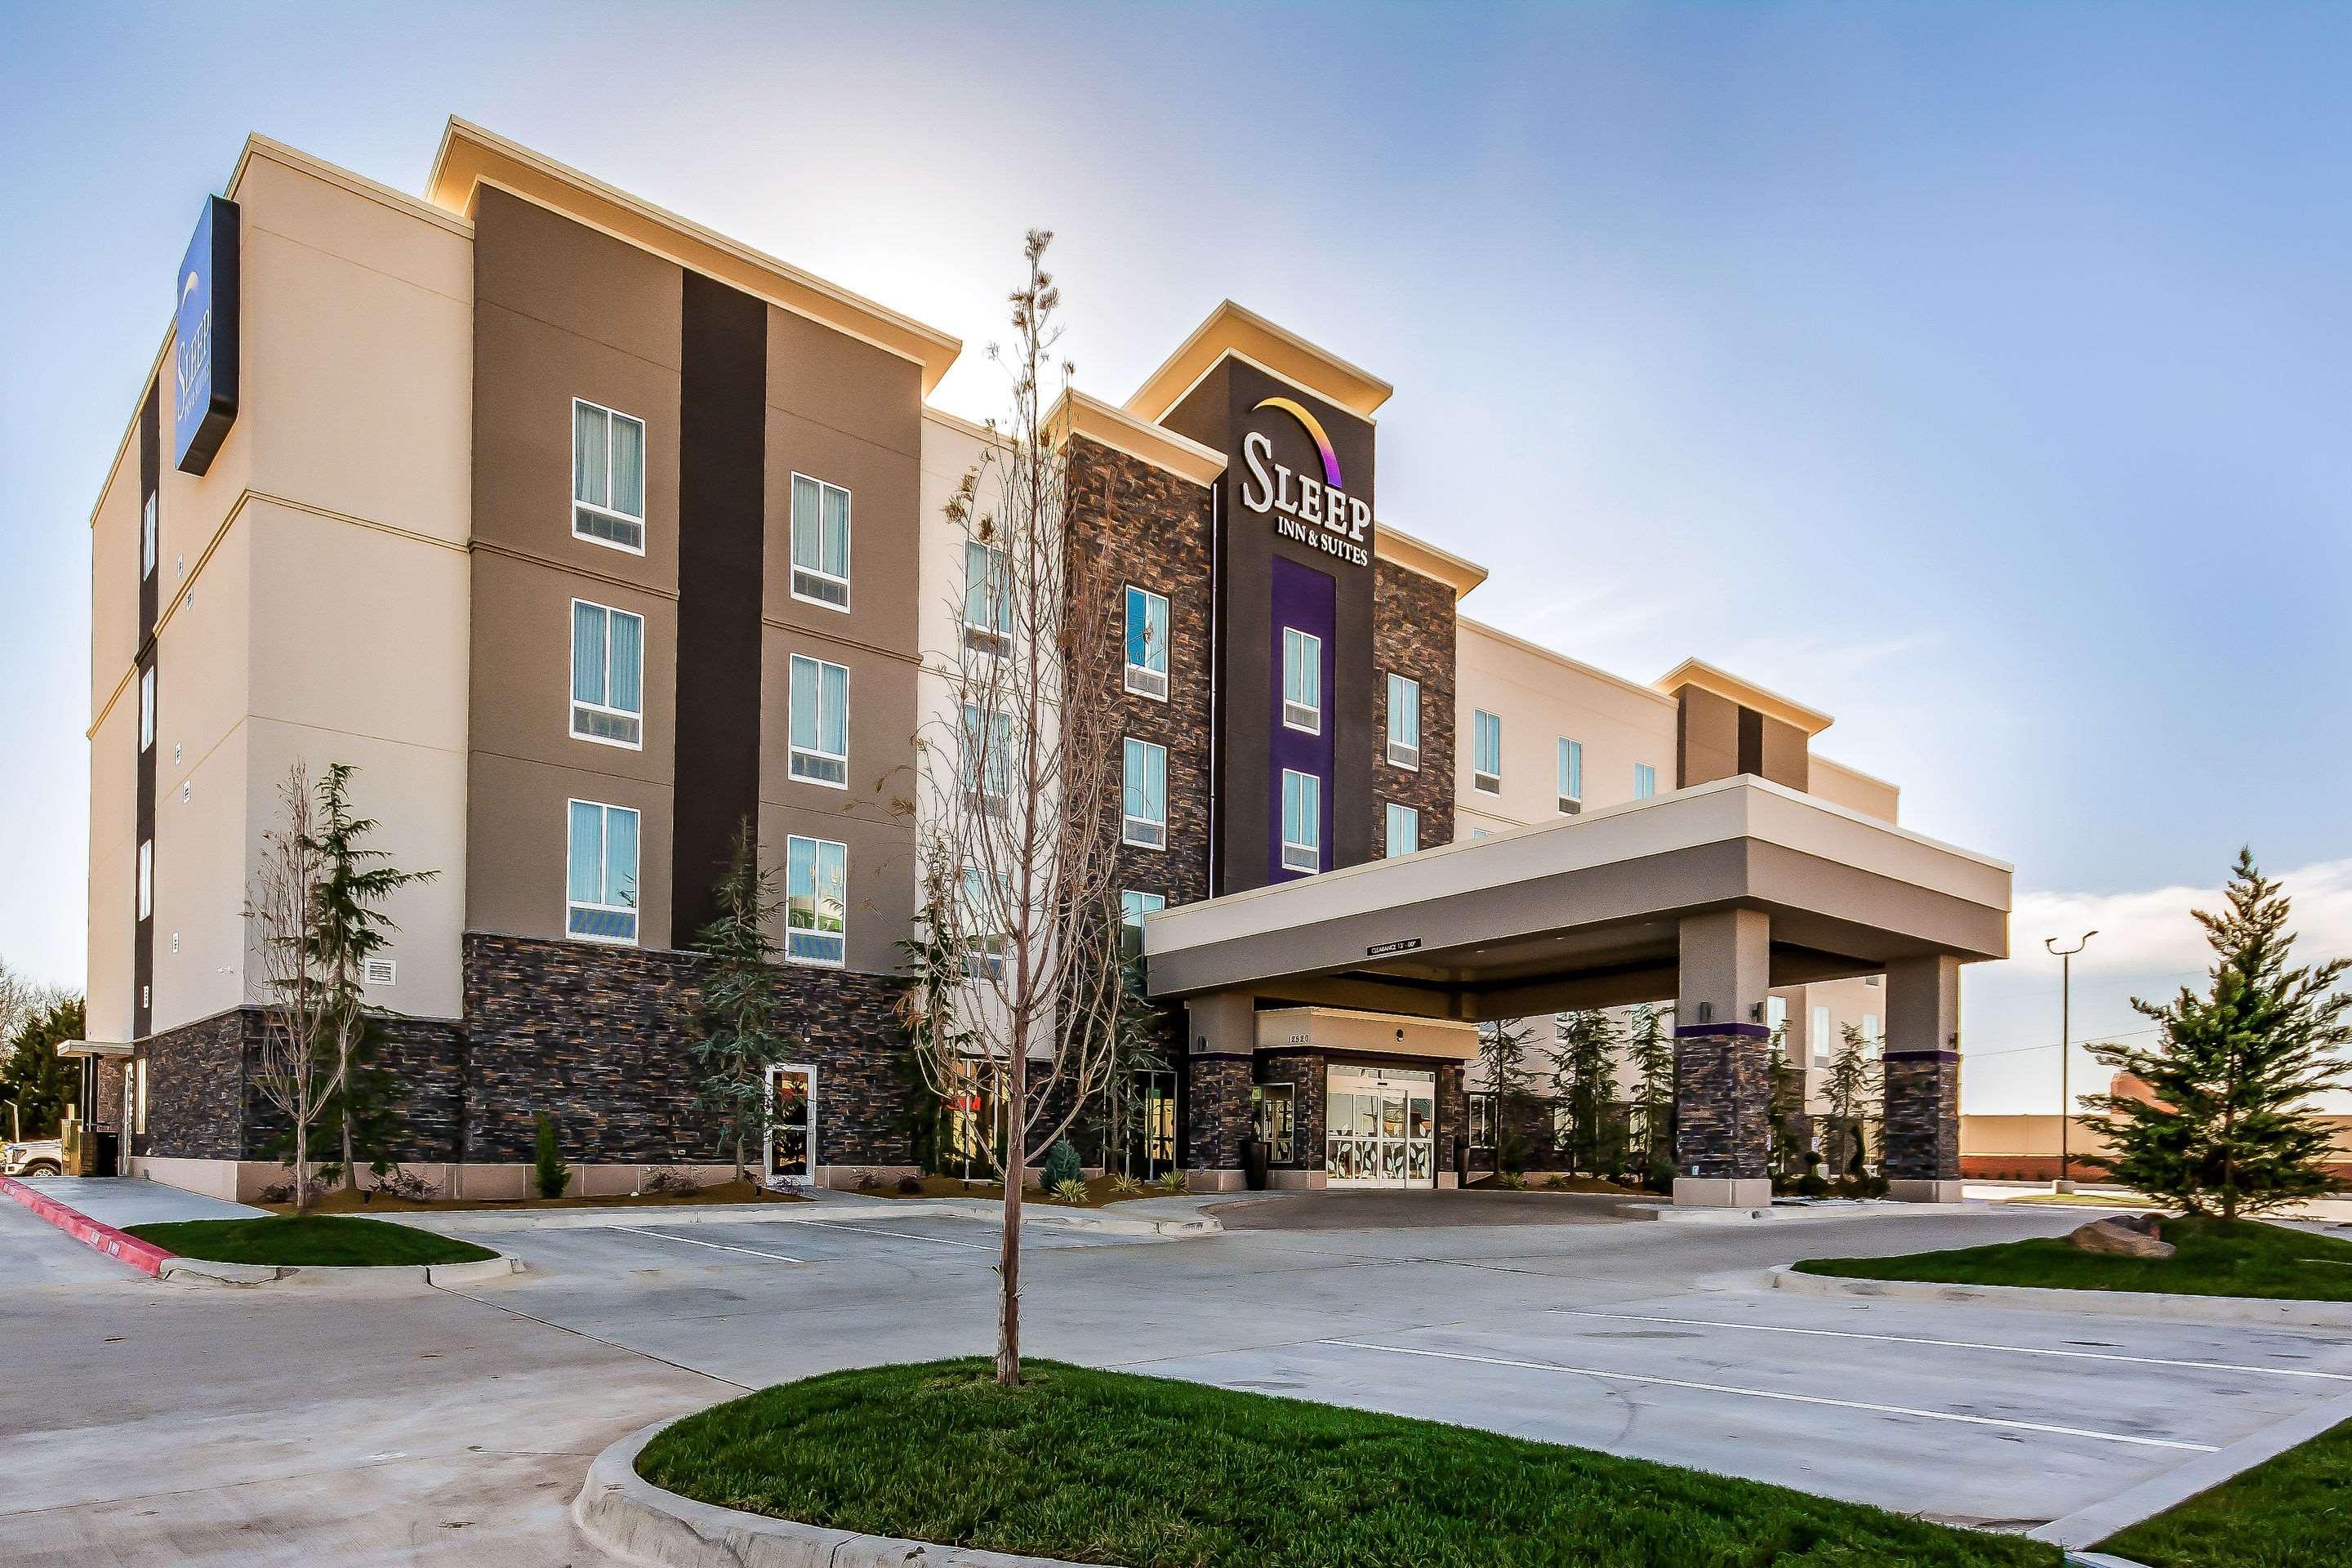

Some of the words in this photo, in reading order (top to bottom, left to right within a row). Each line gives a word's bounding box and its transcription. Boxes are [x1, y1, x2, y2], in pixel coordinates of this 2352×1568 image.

[177, 307, 210, 423] SLEEP
[1242, 431, 1371, 542] SLEEP
[1277, 515, 1307, 542] INN
[1308, 529, 1319, 548] &
[1321, 532, 1368, 567] SUITES
